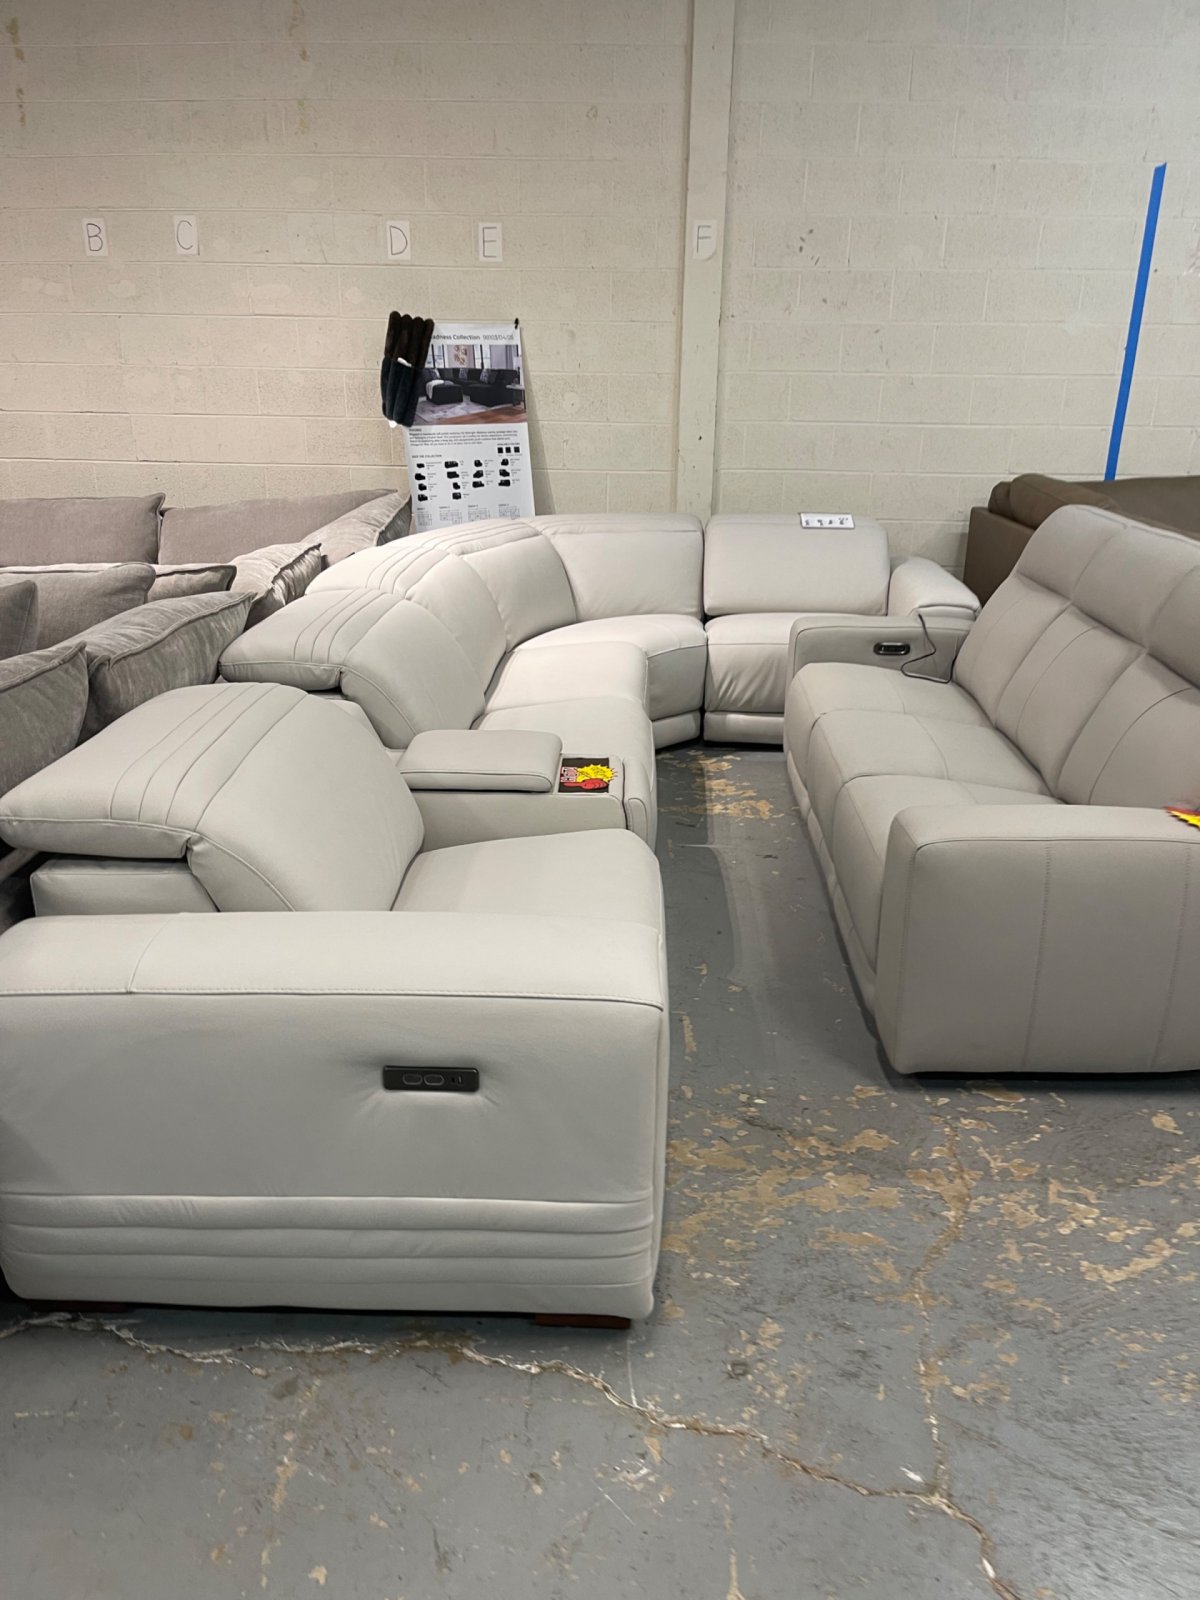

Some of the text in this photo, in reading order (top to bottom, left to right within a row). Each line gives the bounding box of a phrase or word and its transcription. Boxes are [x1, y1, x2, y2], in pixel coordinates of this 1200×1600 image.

[86, 222, 104, 252] B
[176, 219, 195, 251] C
[389, 224, 408, 256] D
[482, 226, 498, 258] E
[696, 224, 712, 254] F
